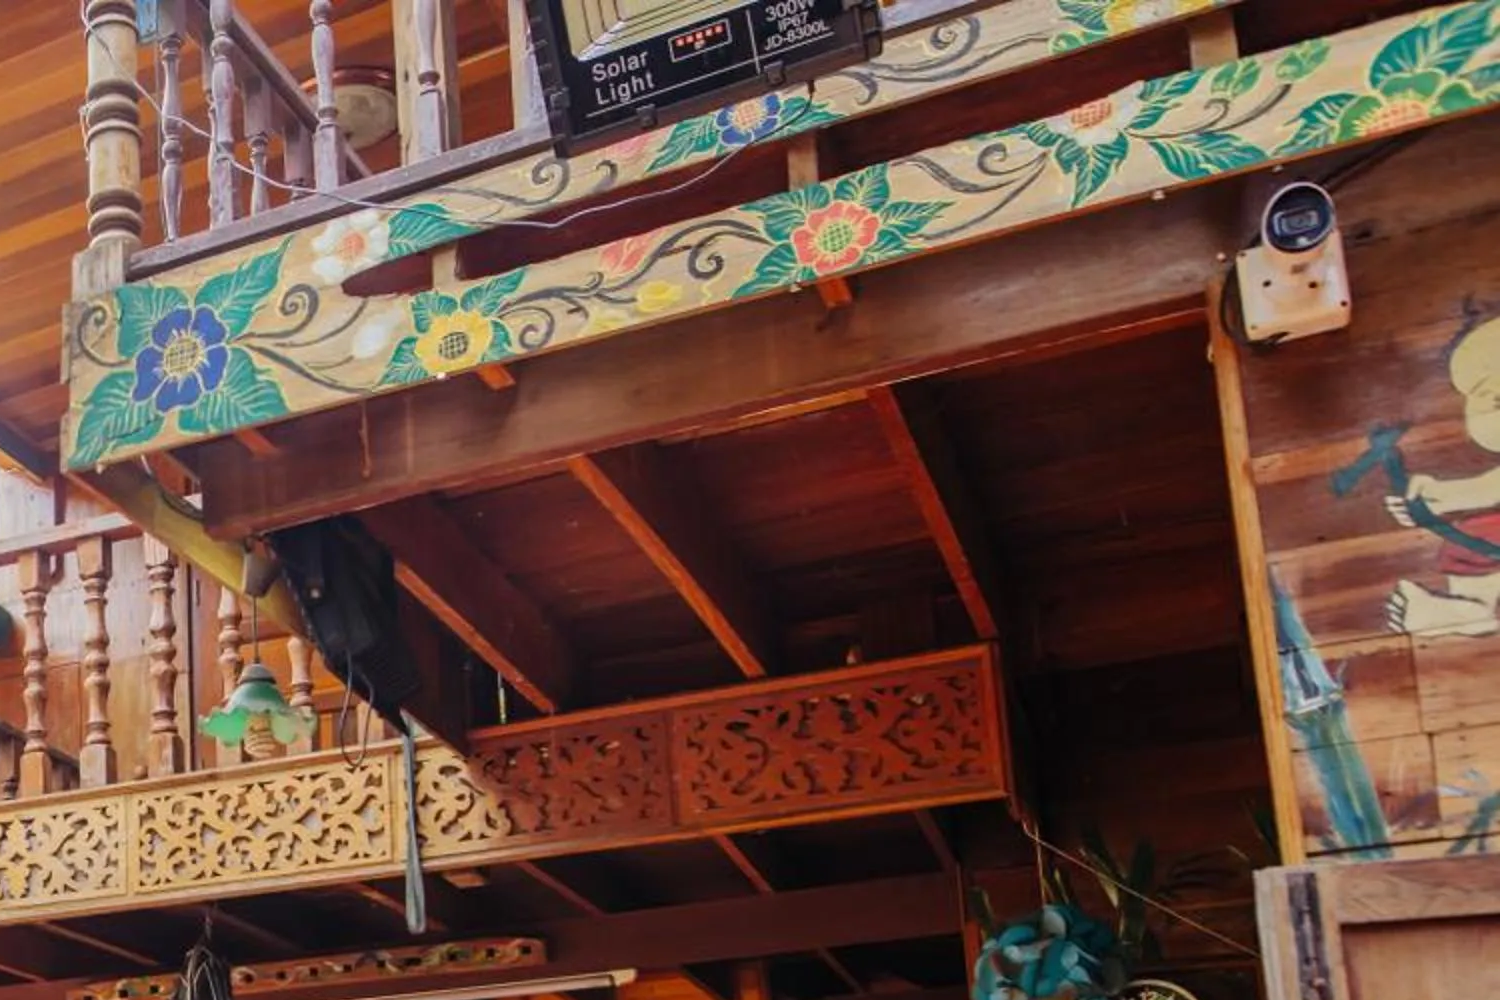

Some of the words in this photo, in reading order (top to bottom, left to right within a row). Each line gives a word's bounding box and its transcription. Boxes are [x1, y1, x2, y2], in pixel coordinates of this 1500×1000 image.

[765, 0, 815, 21] 300W
[778, 11, 809, 32] IP67
[592, 51, 648, 82] Solar
[595, 72, 655, 105] Light
